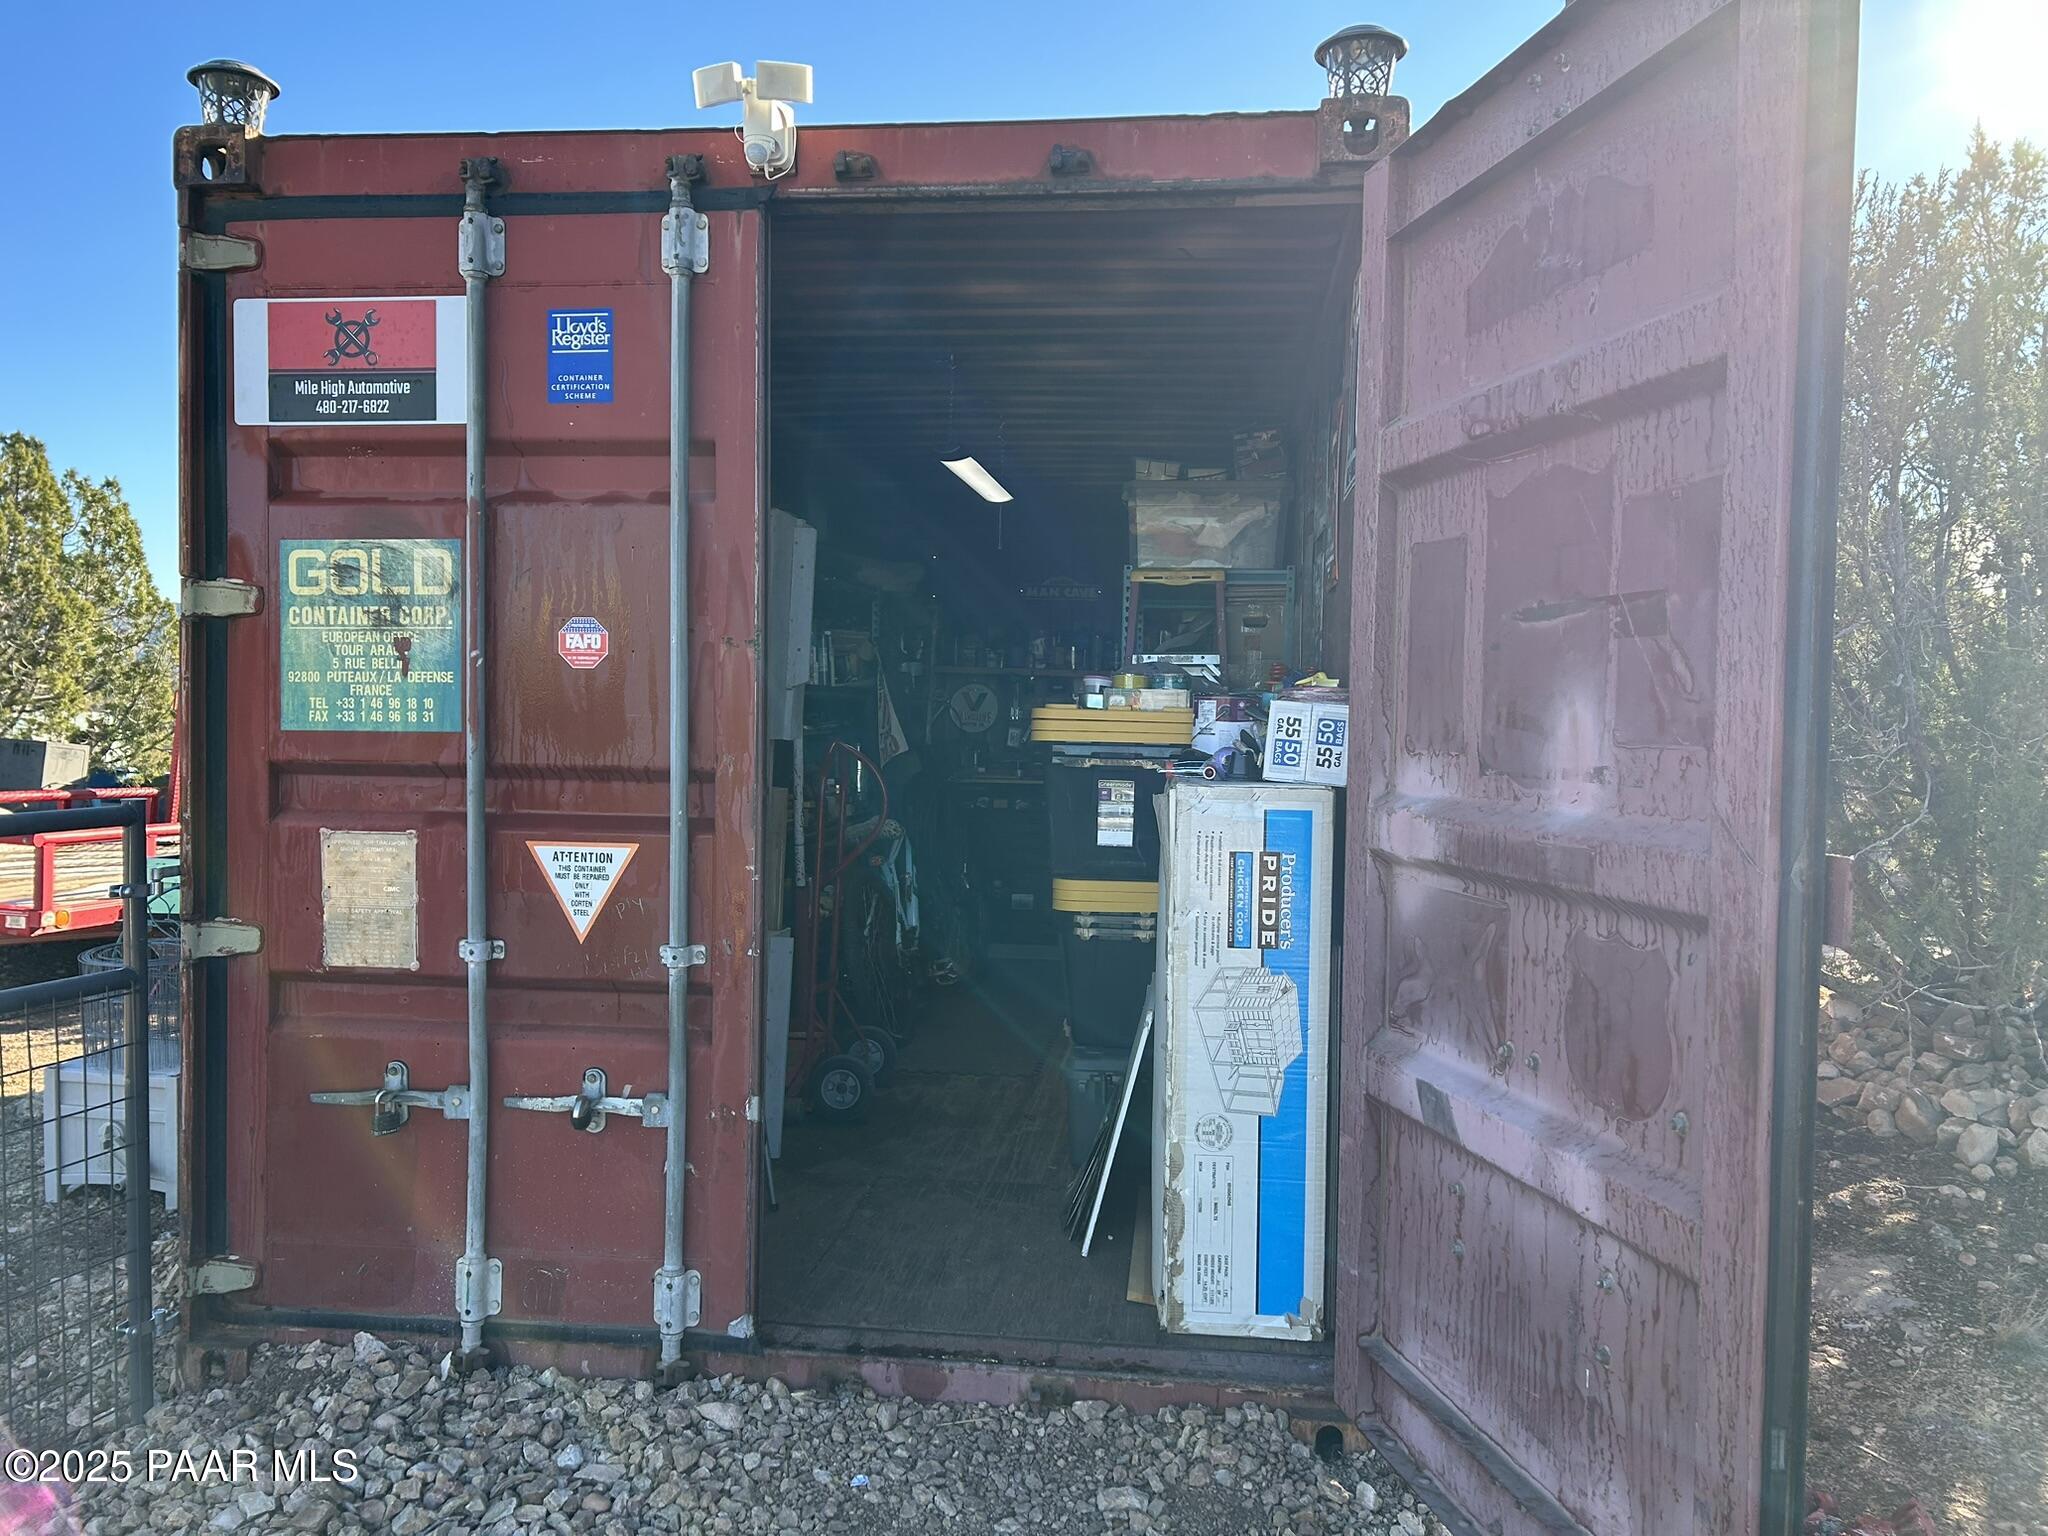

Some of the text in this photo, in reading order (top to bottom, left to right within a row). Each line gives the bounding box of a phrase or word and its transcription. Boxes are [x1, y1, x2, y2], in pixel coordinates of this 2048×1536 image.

[556, 316, 607, 334] Lloyd's
[551, 329, 610, 350] Register
[557, 374, 603, 382] CONTAINER
[294, 379, 411, 398] Mile High Automotive
[551, 383, 610, 391] CERTIFICATION
[564, 392, 597, 400] SCHEME
[315, 399, 390, 414] 480-217-6822
[288, 548, 453, 596] GOLD
[399, 605, 453, 625] CORP.
[321, 631, 380, 643] EUROPEAN
[565, 633, 601, 649] FAFO
[334, 644, 363, 656] TOUR
[332, 658, 339, 669] 5
[345, 658, 366, 669] RUE
[288, 671, 320, 683] 92800
[407, 671, 454, 683] DEFENSE
[349, 684, 392, 696] FRANCE
[309, 697, 434, 709] TEL +33 1 46 96 18 10
[309, 710, 434, 722] FAX +33 1 46 96 18 31
[1274, 717, 1284, 764] GAL BAGS
[1283, 716, 1302, 765] 55 50
[1315, 720, 1335, 769] 55 50
[1333, 721, 1345, 768] GAL BAGS
[558, 864, 607, 873] THIS CONTAINER
[555, 872, 570, 880] MUST
[582, 873, 610, 881] REPAIRED
[1235, 858, 1246, 941] CHICKEN COOP
[1261, 855, 1278, 946] PRIDE
[1280, 853, 1297, 950] Producer's
[573, 909, 590, 917] STEEL
